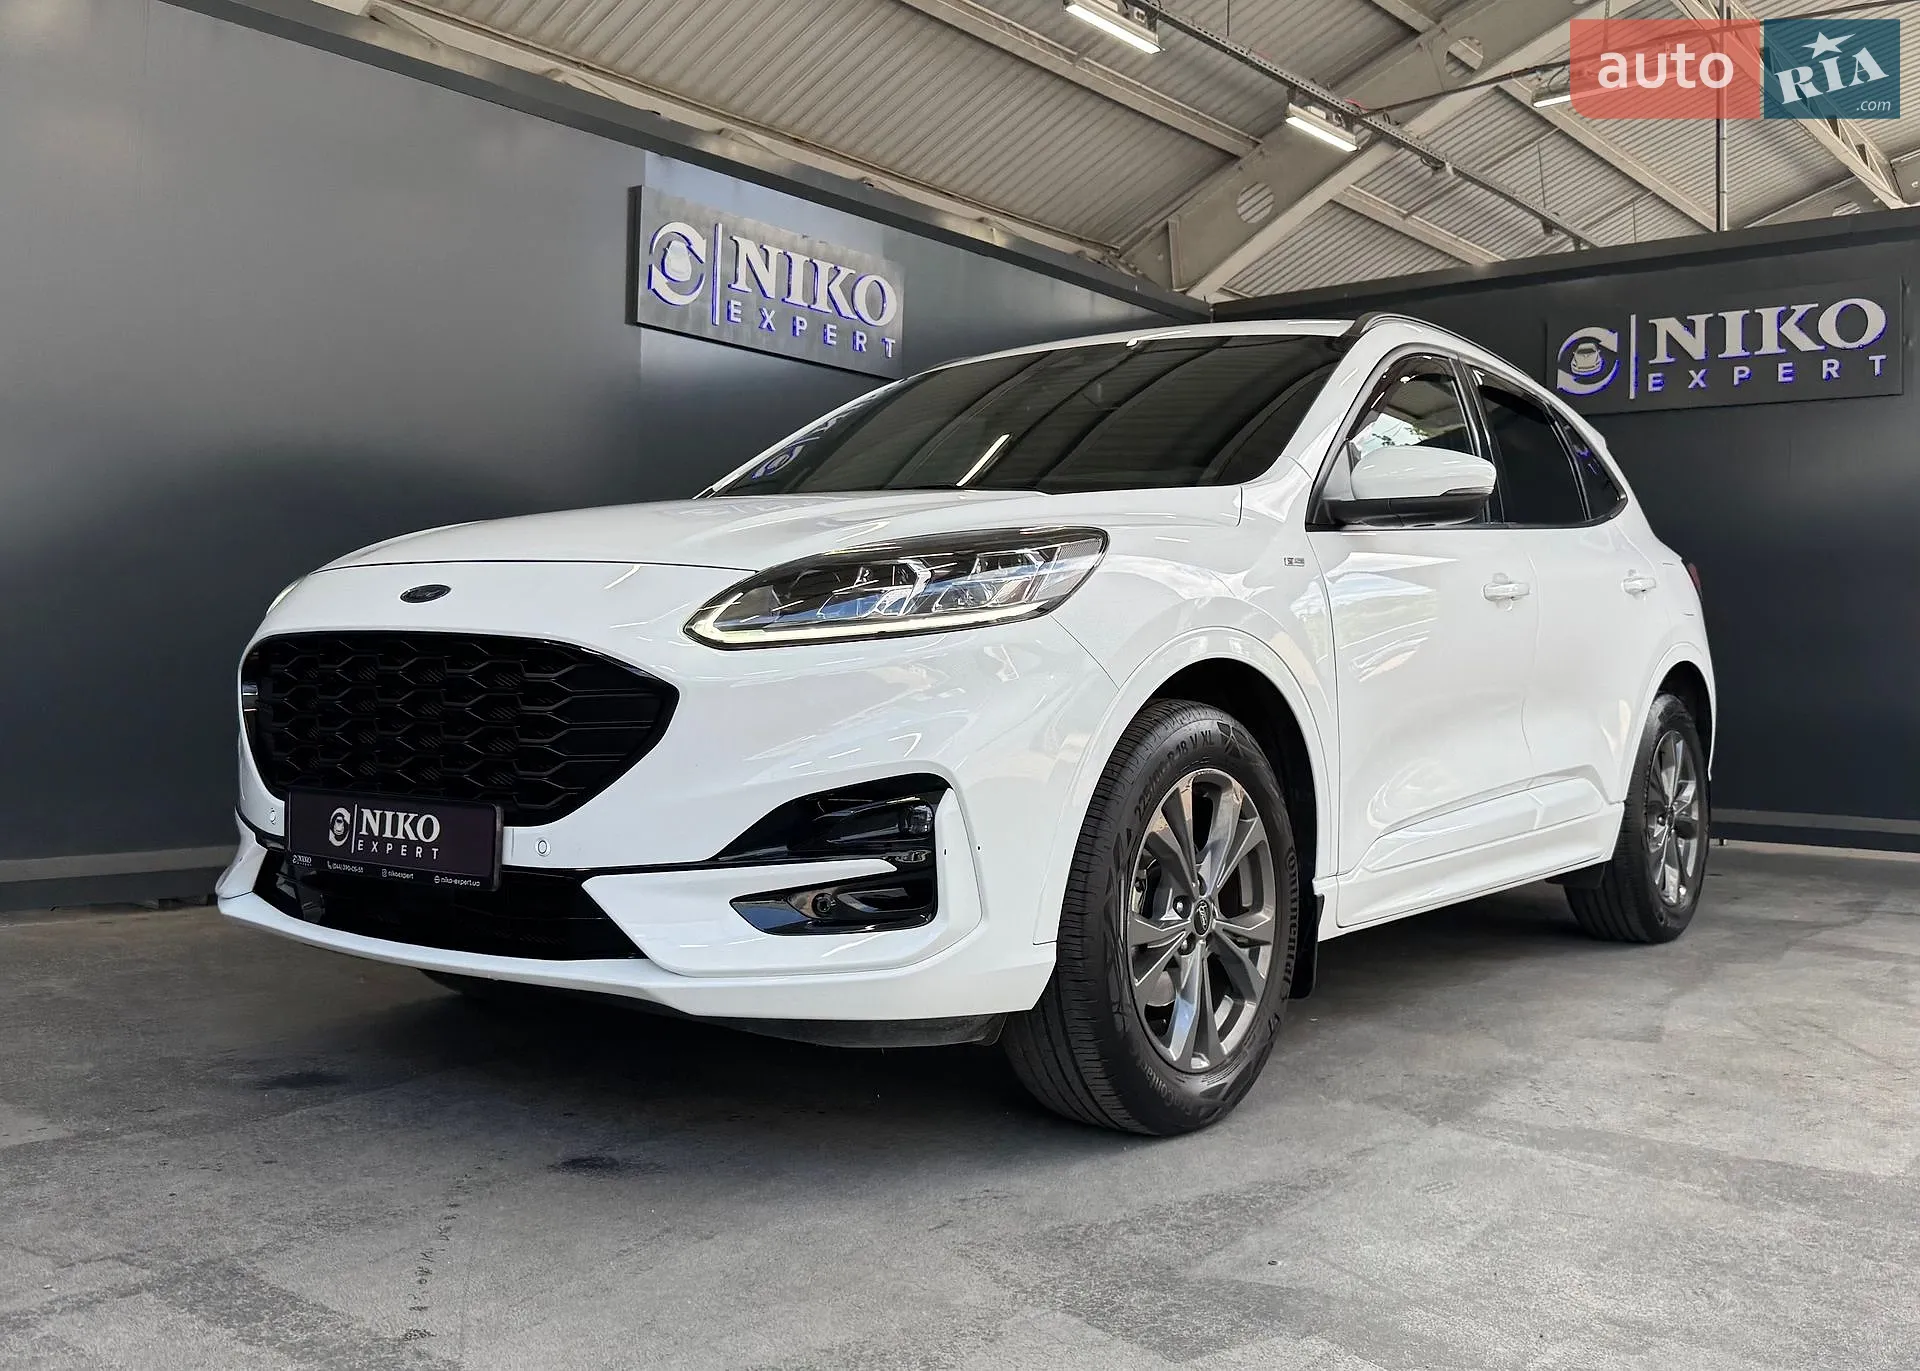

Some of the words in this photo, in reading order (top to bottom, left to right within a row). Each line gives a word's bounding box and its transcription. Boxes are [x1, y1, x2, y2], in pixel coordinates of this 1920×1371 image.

[728, 235, 898, 327] NIKO
[727, 300, 897, 358] EXPERT
[1647, 297, 1887, 365] NIKO
[1647, 354, 1888, 393] EXPERT
[358, 808, 441, 843] NIKO
[357, 839, 440, 861] EXPERT
